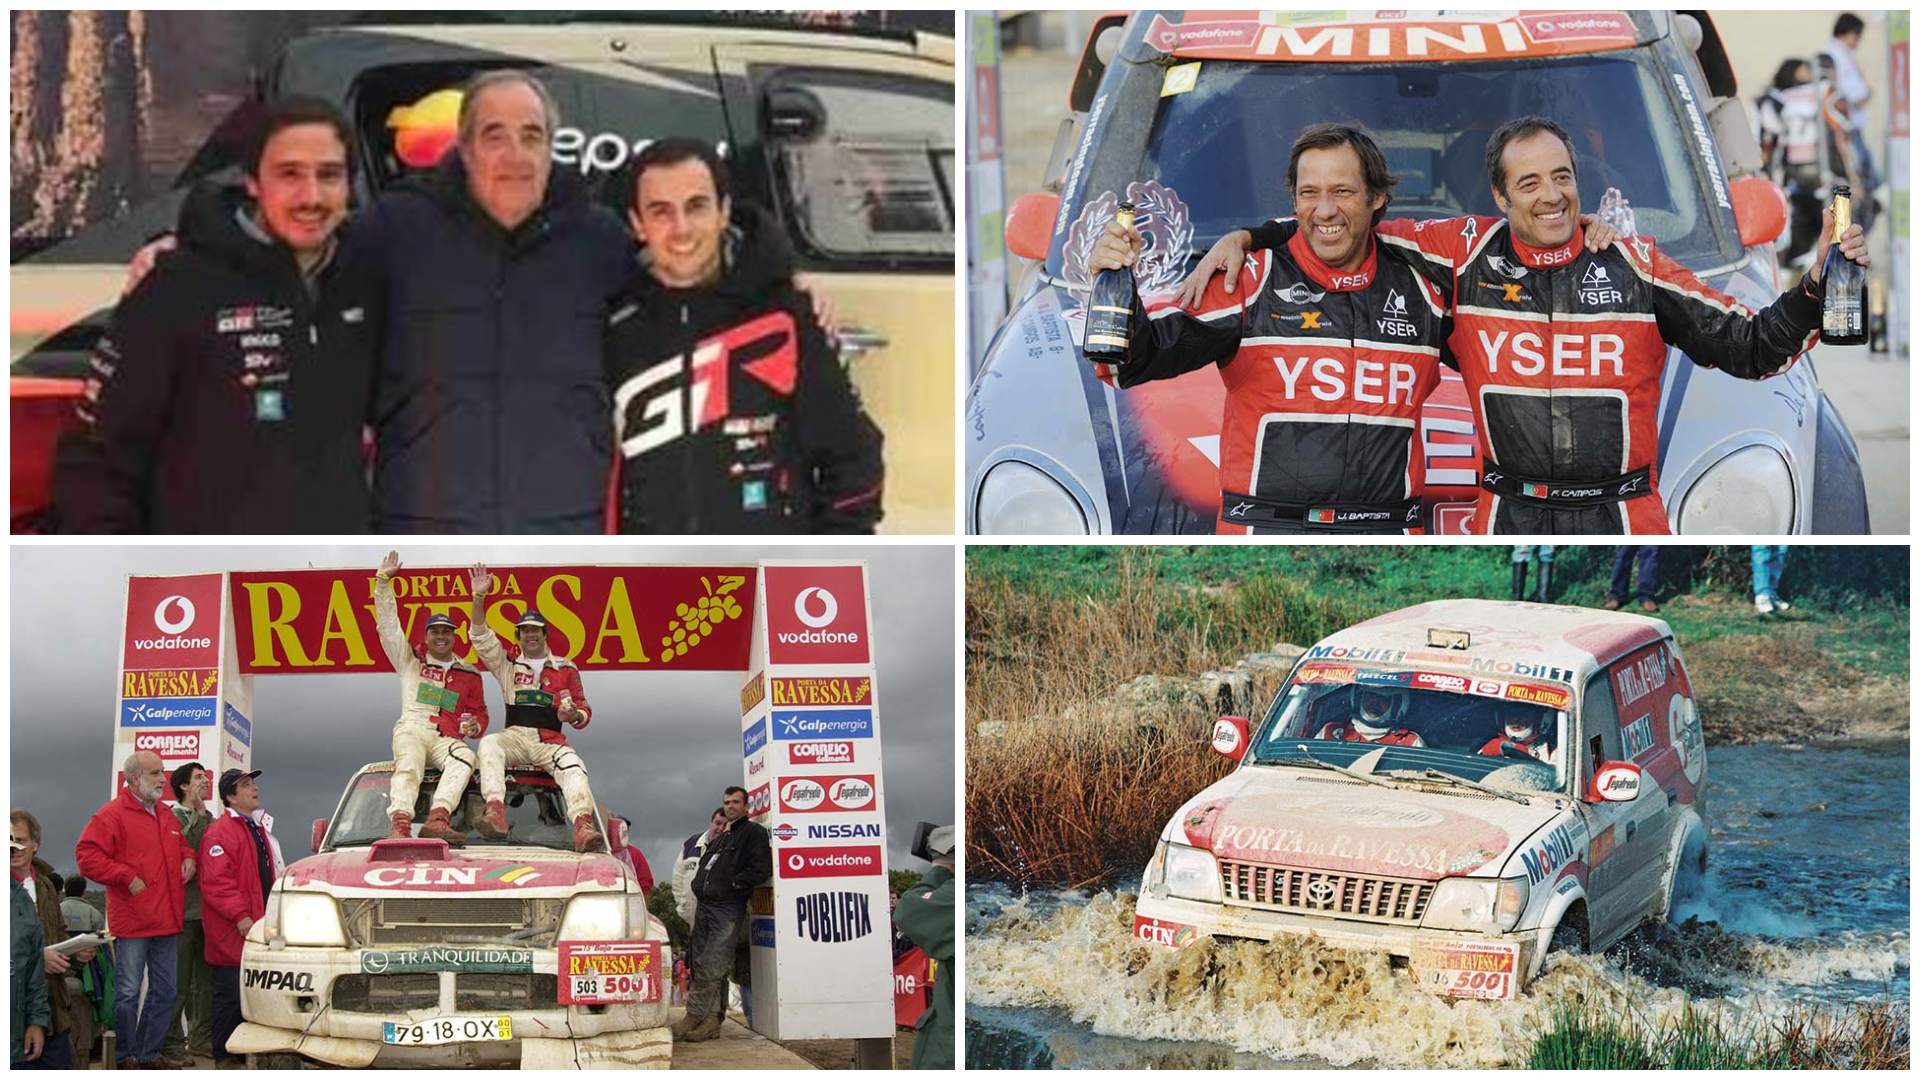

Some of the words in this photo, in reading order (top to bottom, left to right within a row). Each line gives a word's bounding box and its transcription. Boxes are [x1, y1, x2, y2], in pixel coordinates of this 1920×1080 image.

[1558, 20, 1620, 30] vodafone
[1180, 28, 1243, 40] vodafone
[1256, 22, 1527, 56] MINI
[1533, 247, 1573, 265] YSER
[1331, 273, 1369, 290] YSER
[1577, 290, 1623, 305] YSER
[1376, 320, 1418, 337] YSER
[1477, 330, 1625, 377] YSER
[1272, 356, 1417, 406] YSER
[1561, 488, 1604, 497] CAMPOS
[1348, 512, 1391, 520] BAPTISTA
[134, 635, 211, 650] vodafone
[778, 629, 858, 645] vodafone
[123, 671, 200, 697] RAVESSA
[773, 679, 853, 704] RAVESSA
[1508, 685, 1528, 698] PORTA
[1535, 689, 1563, 704] RAVESSA
[136, 735, 198, 750] CORREIO
[793, 743, 849, 757] CORREIO
[1602, 775, 1638, 791] Segafredo
[773, 828, 798, 836] NISSAN
[808, 824, 880, 838] NISSAN
[1215, 824, 1305, 852] PORTA
[1328, 835, 1448, 874] RAVESSA
[808, 854, 872, 866] vodafone
[796, 891, 872, 943] PUBLIFIX
[399, 949, 531, 966] TRANQUILIDADE
[569, 954, 636, 975] RAVESSA
[1460, 953, 1498, 971] RAVESSA
[576, 980, 597, 994] 503
[604, 976, 643, 993] 500
[1454, 972, 1501, 990] 500
